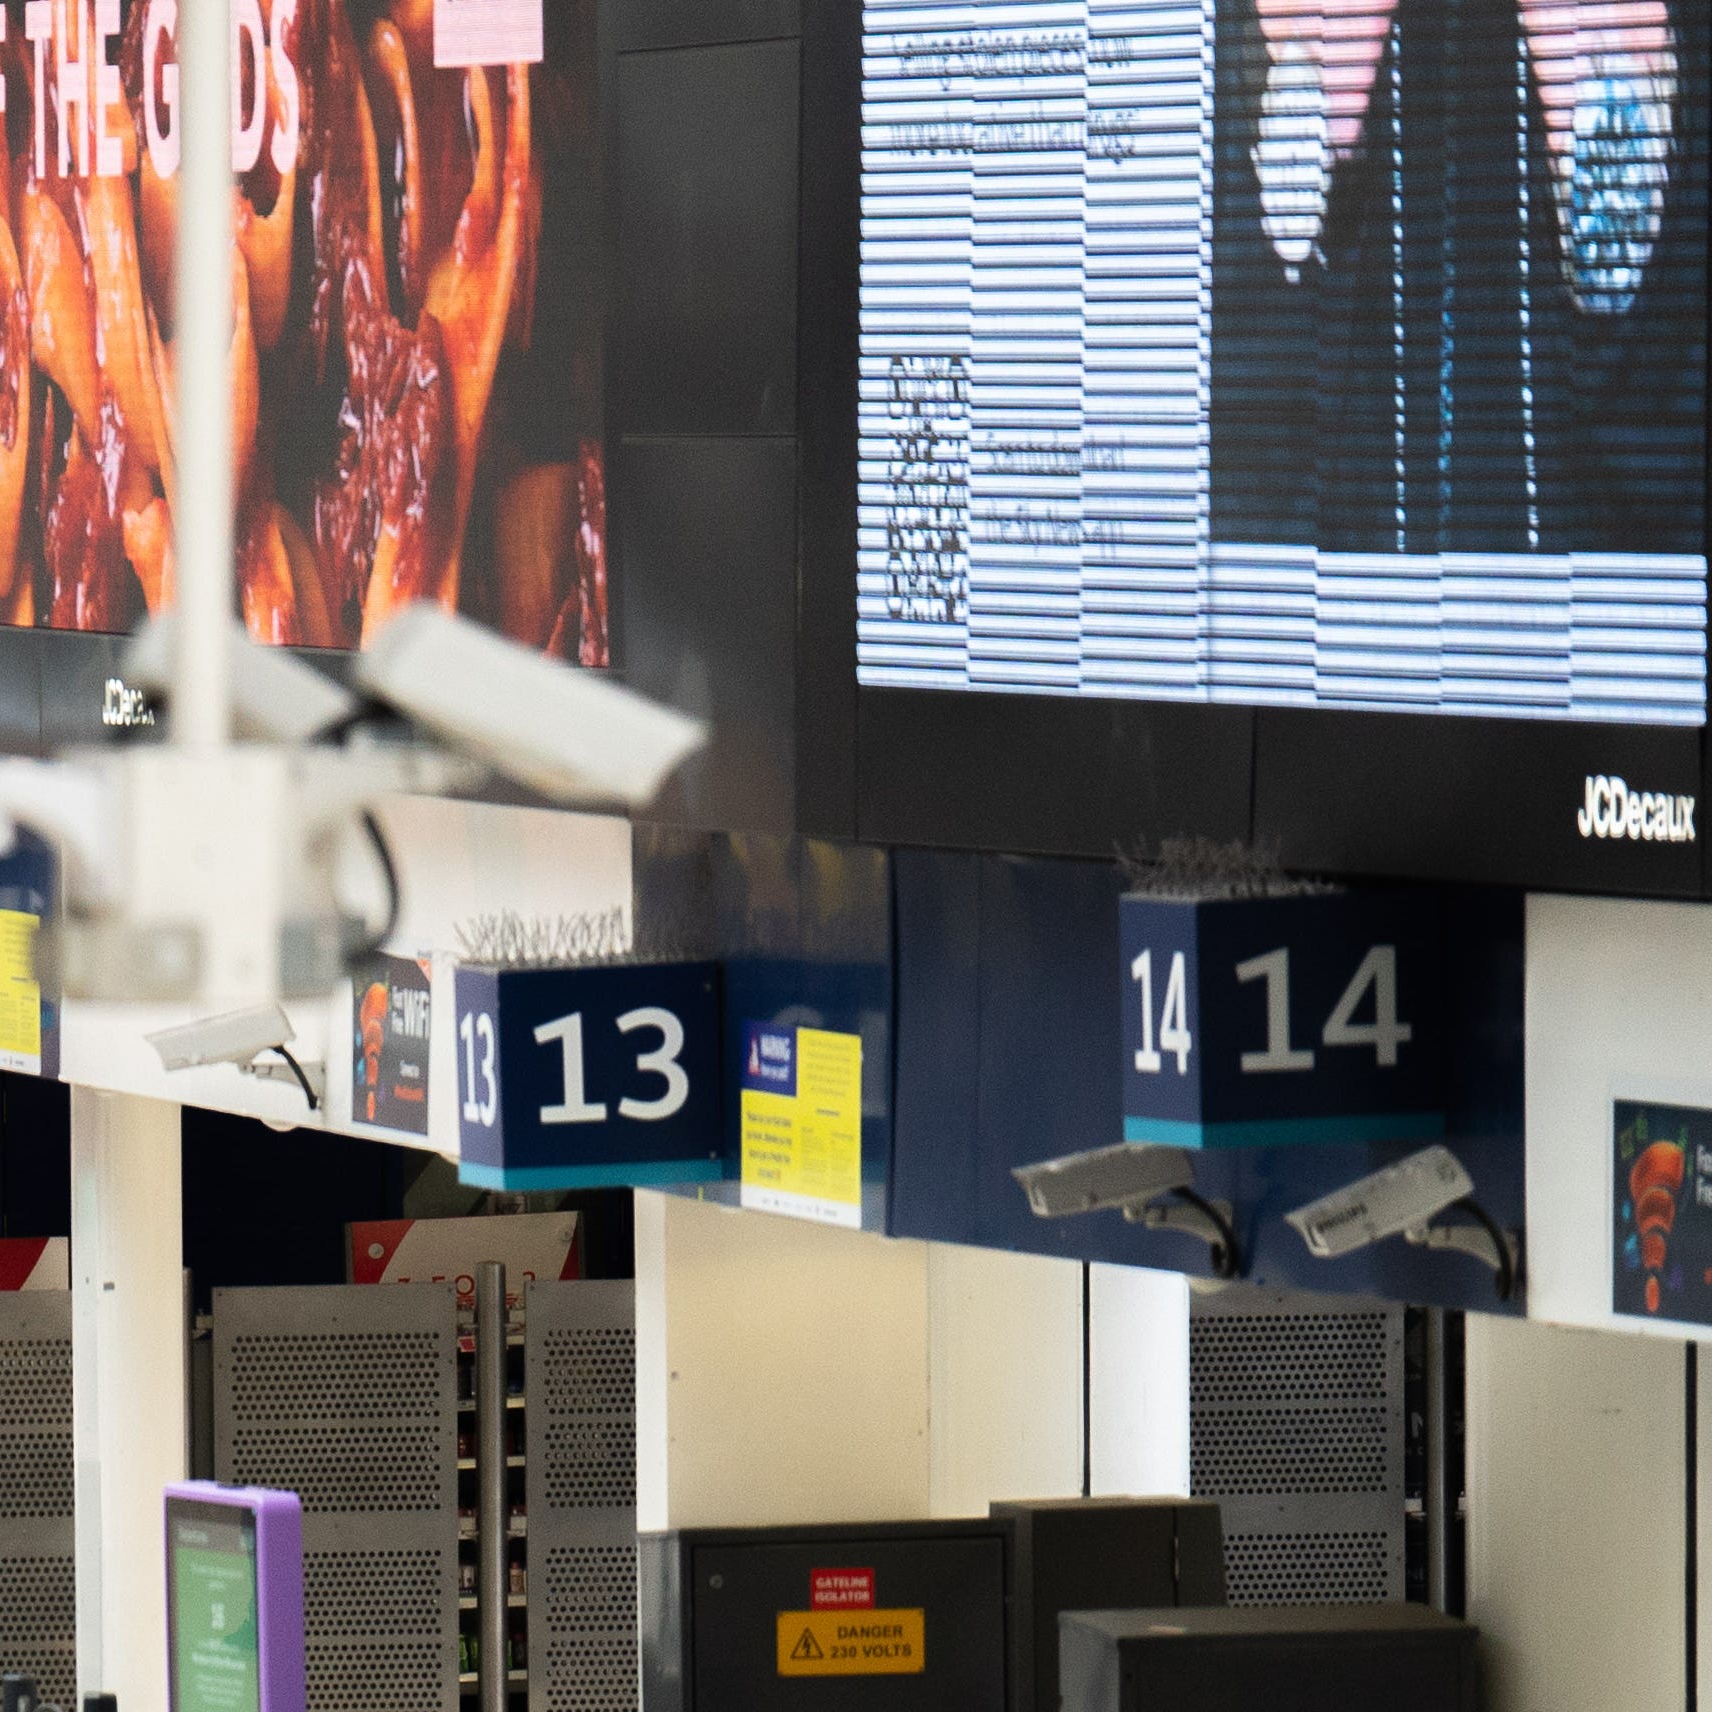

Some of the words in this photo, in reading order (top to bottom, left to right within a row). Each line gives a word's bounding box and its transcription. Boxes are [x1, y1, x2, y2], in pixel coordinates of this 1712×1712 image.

[26, 5, 122, 178] THE
[142, 4, 298, 180] GDS
[1578, 776, 1695, 842] JCDecaux
[1131, 947, 1192, 1076] 14
[1235, 944, 1413, 1074] 14
[460, 1011, 498, 1128] 13
[533, 1006, 690, 1125] 13
[815, 1576, 870, 1588] GATELINE
[830, 1645, 858, 1660] 230
[862, 1641, 913, 1659] VOLTS
[837, 1625, 904, 1640] DANGER
